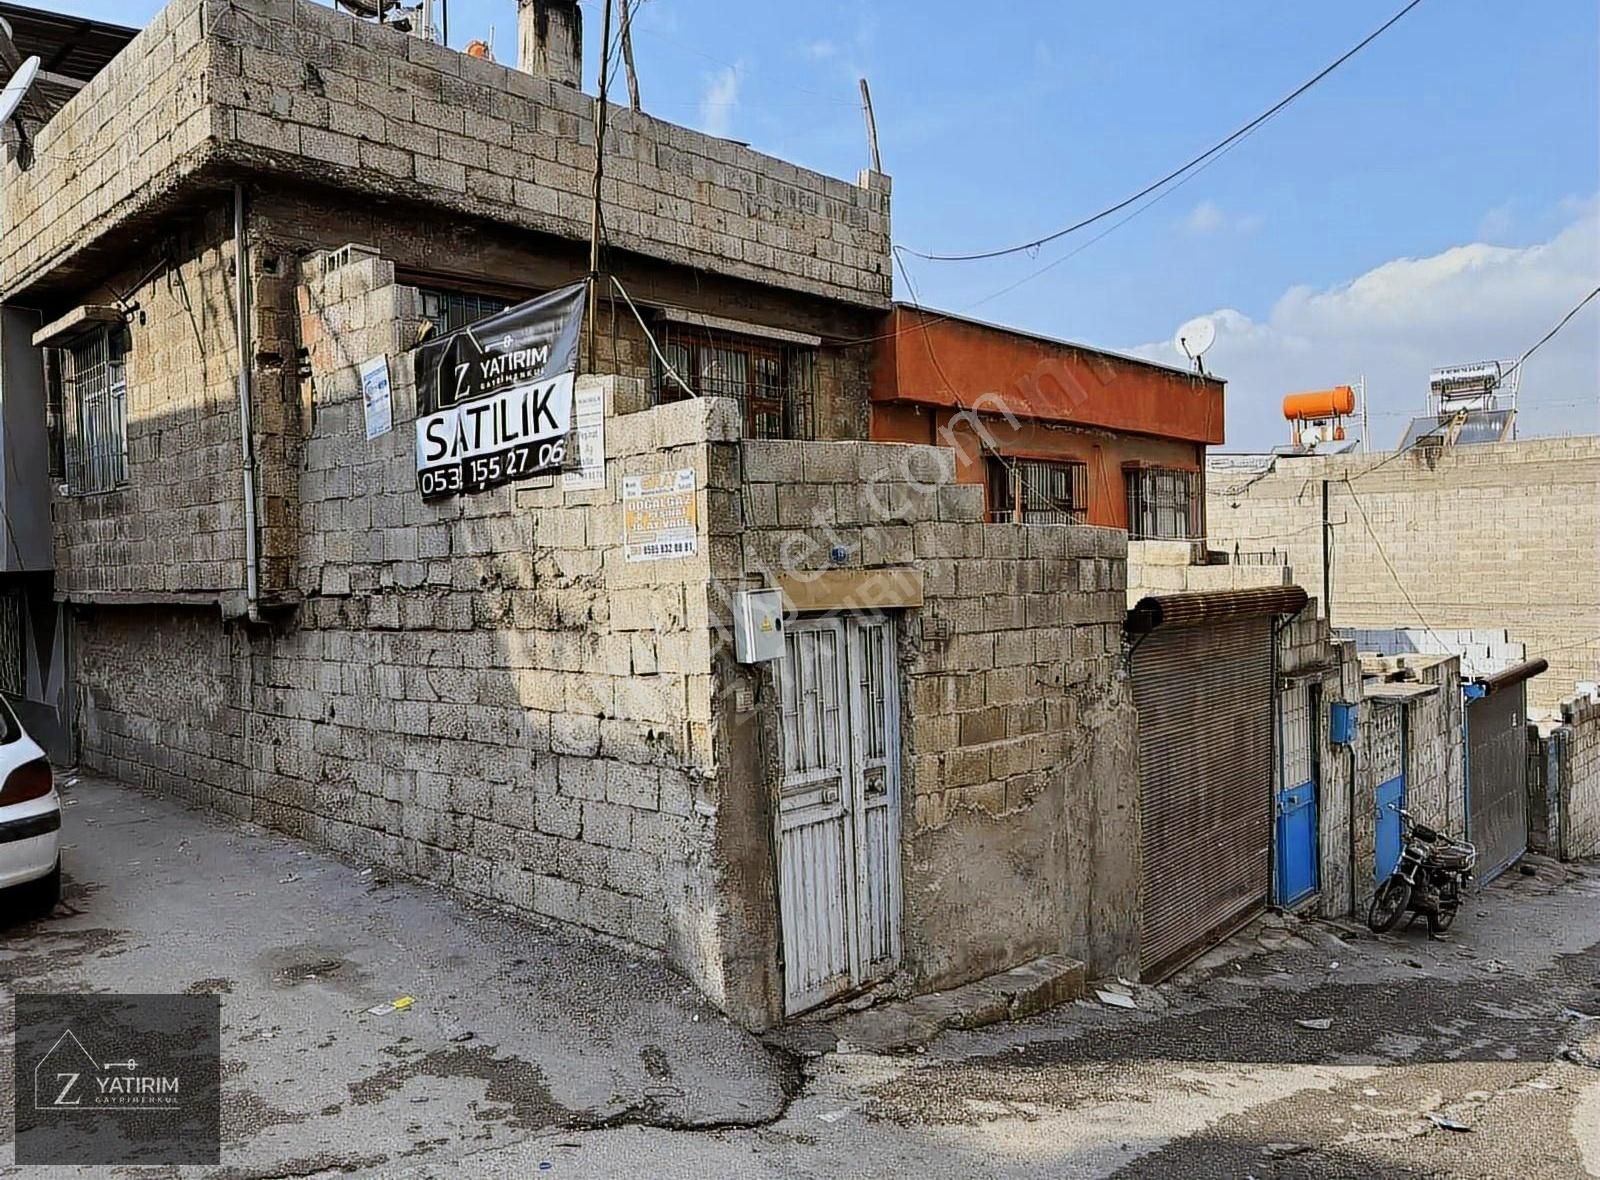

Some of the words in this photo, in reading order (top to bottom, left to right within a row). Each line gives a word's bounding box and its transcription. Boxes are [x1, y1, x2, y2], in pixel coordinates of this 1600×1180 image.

[454, 362, 471, 400] Z
[480, 347, 549, 379] YATIRIM
[426, 383, 559, 462] SATILIK
[470, 455, 500, 483] 155
[506, 446, 529, 475] 27
[538, 438, 565, 467] 06
